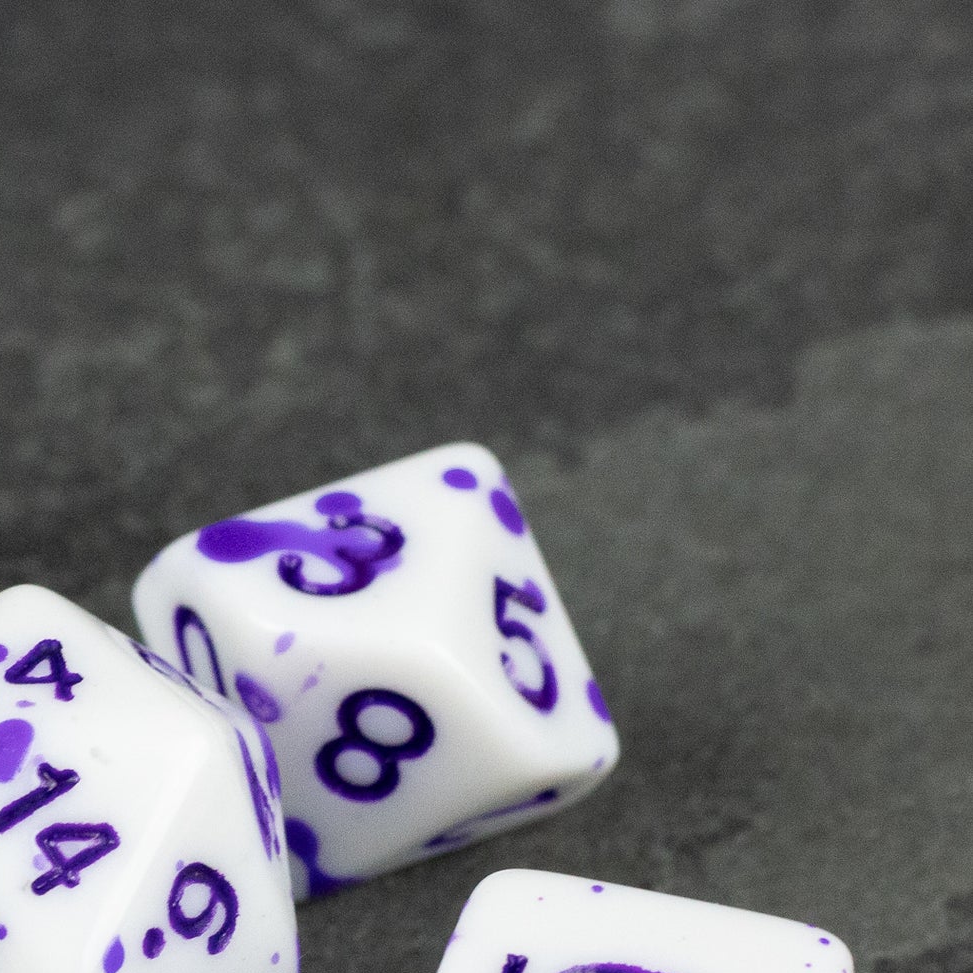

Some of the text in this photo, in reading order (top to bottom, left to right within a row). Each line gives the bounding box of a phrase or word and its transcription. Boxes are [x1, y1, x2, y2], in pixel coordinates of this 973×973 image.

[277, 513, 405, 596] 3
[5, 639, 84, 701] 4
[495, 576, 559, 714] 5
[315, 688, 436, 803] 8
